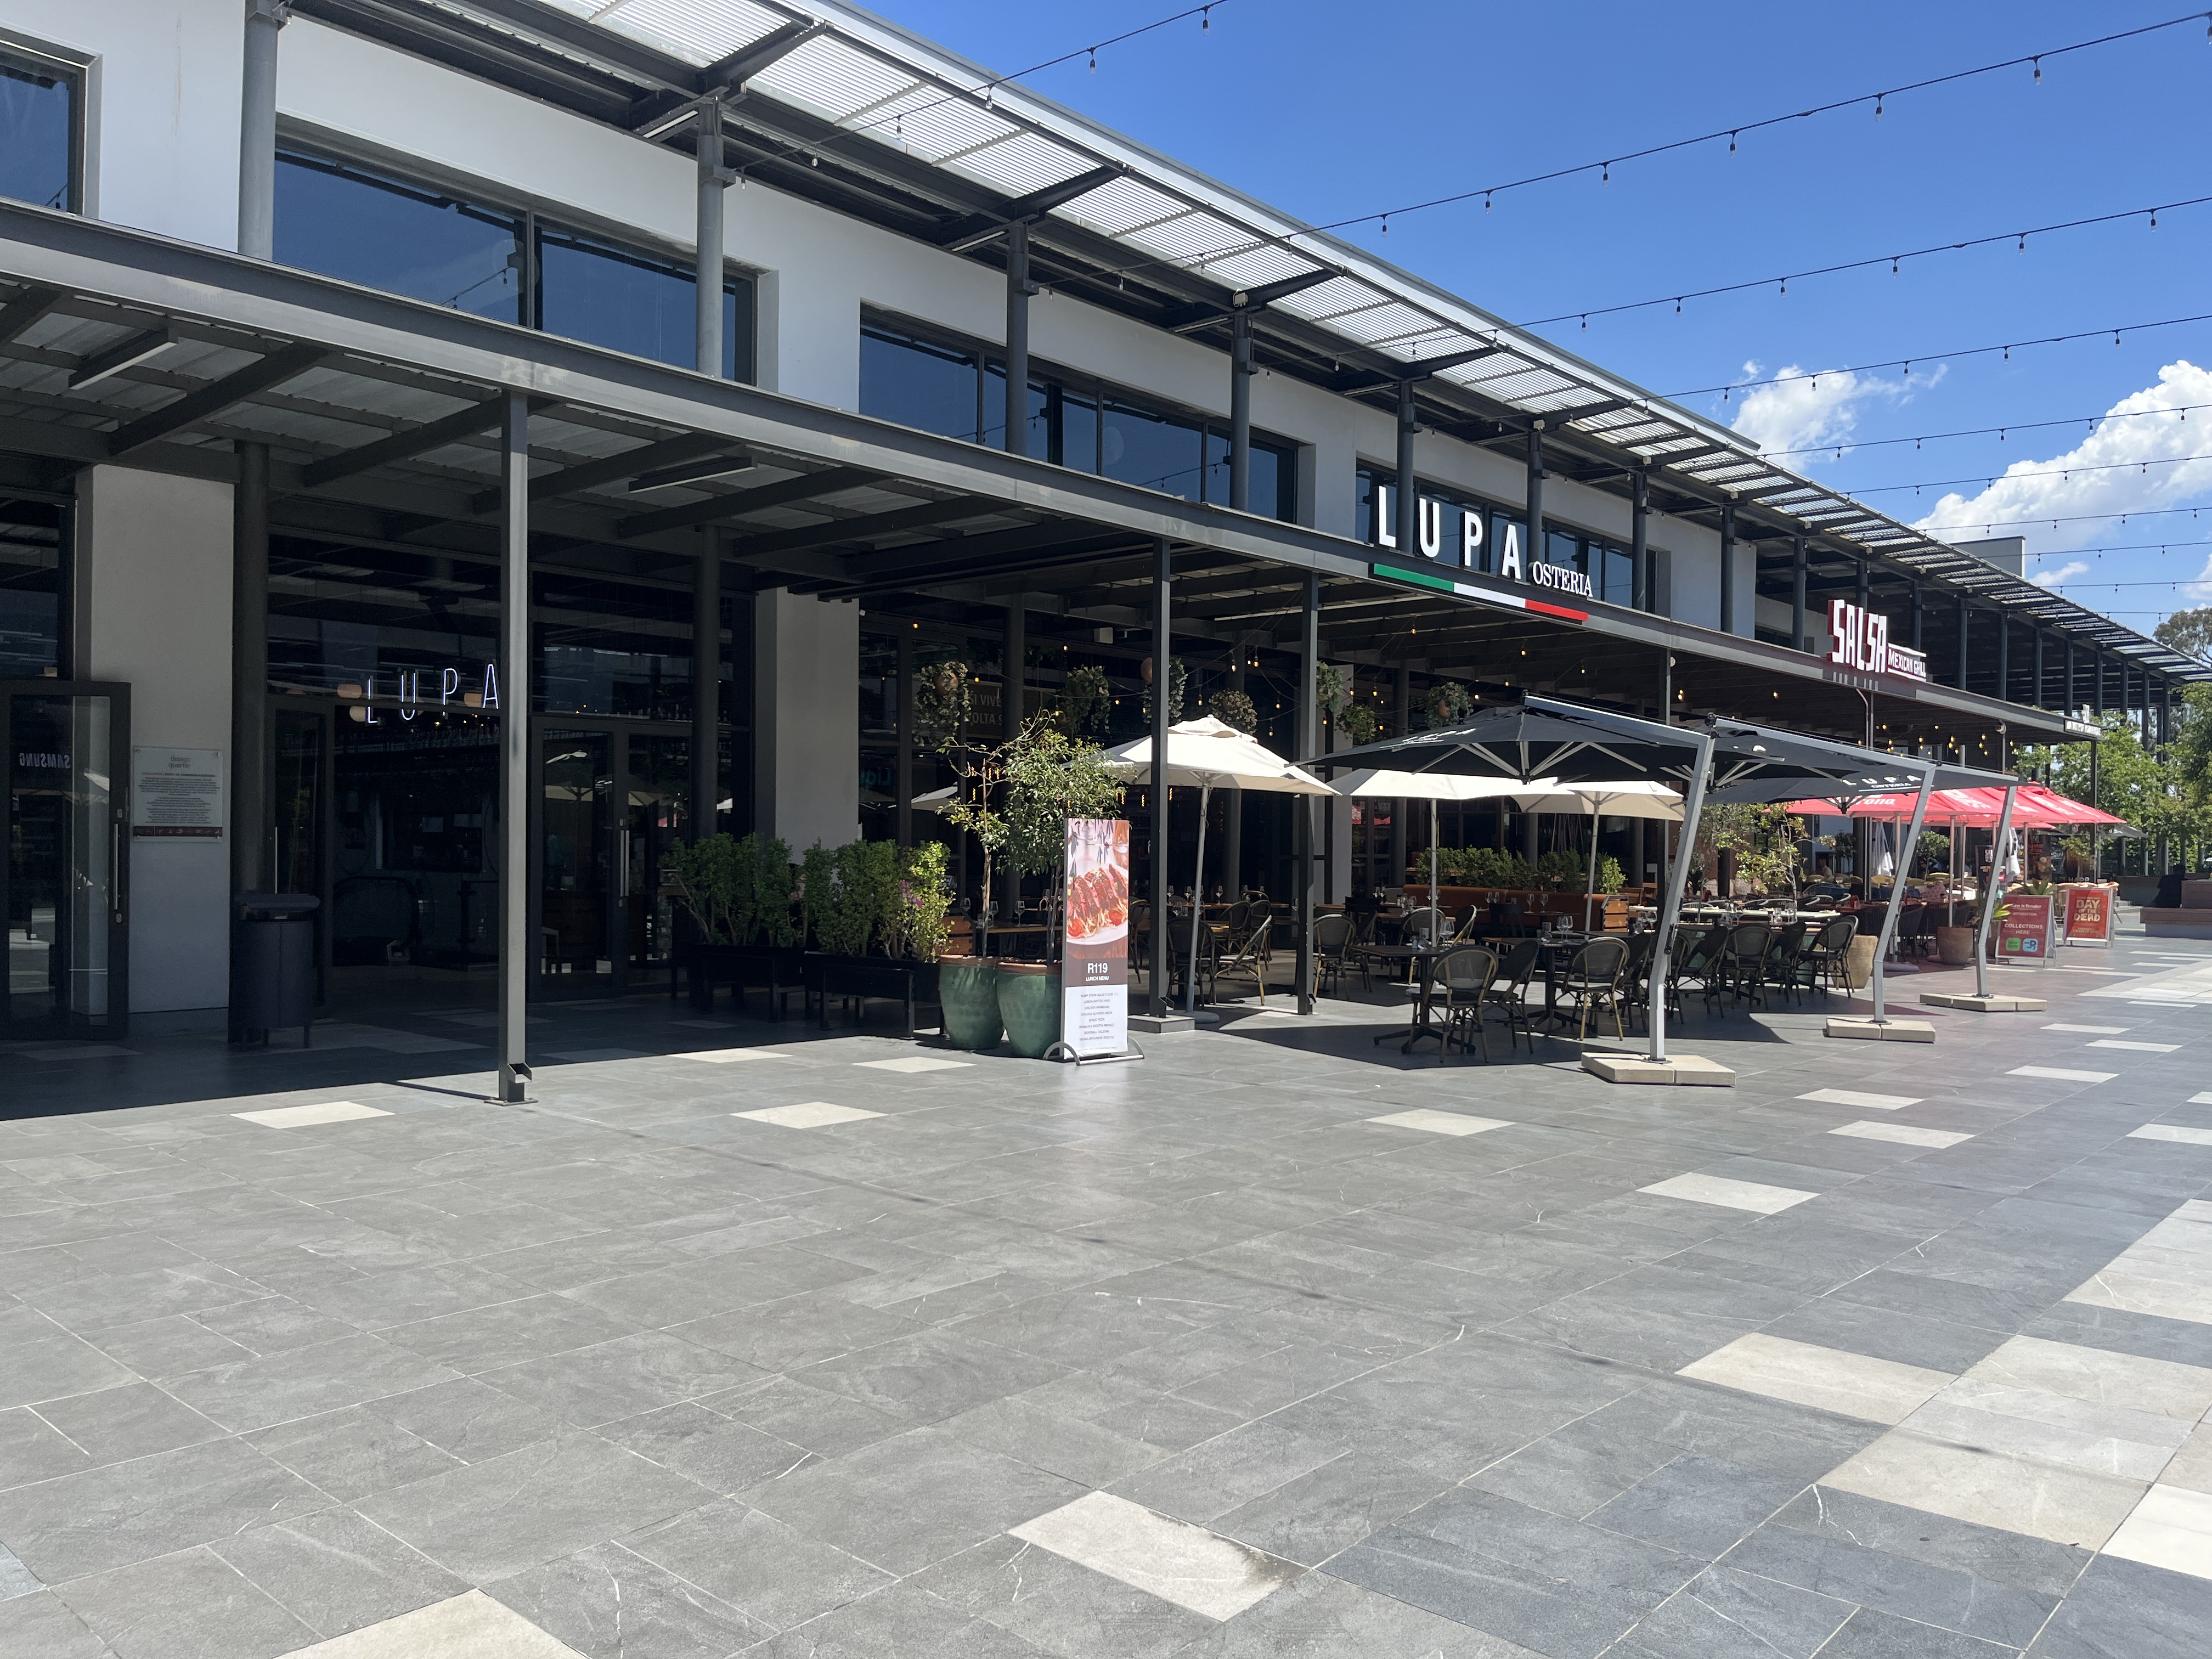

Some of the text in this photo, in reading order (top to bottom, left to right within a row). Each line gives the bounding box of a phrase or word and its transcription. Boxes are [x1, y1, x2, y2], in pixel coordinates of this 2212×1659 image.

[1378, 486, 1521, 579] LUPA
[1532, 560, 1593, 597] OSTERIA
[1831, 599, 1887, 673] SALSA
[1888, 648, 1926, 678] MEXICAN GRILL
[367, 663, 499, 724] LUPA
[980, 695, 1002, 707] VIVE
[1842, 775, 1922, 786] LUPA
[2076, 899, 2100, 909] DAY
[2074, 913, 2101, 922] DEAD
[1087, 962, 1108, 974] R119
